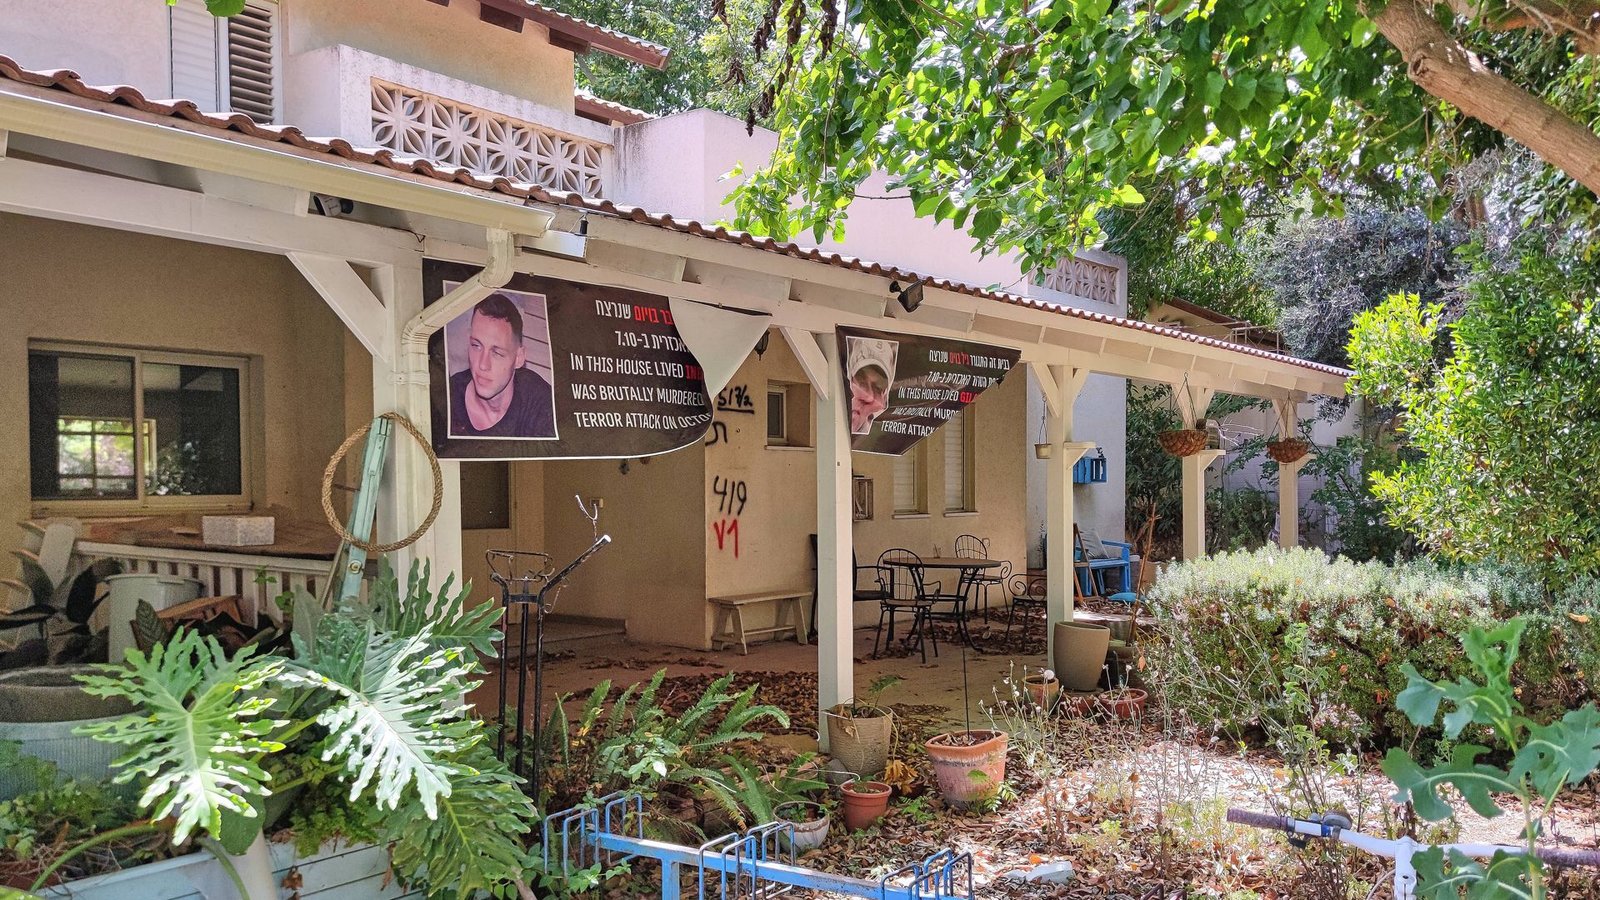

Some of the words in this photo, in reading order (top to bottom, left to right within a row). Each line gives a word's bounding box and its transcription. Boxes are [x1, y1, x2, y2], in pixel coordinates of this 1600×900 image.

[596, 300, 632, 320] שנרצח
[634, 306, 659, 322] בוים
[652, 334, 688, 352] אכזרית
[570, 352, 584, 371] IN
[586, 356, 614, 374] THIS
[616, 358, 653, 376] HOUSE
[654, 362, 684, 378] LIVED
[929, 350, 948, 362] שנרצח
[571, 384, 597, 400] WAS
[600, 385, 654, 402] BRUTALLY
[656, 388, 705, 406] MURDERED
[898, 386, 906, 399] IN
[906, 388, 921, 399] THIS
[921, 388, 941, 400] HOUSE
[574, 412, 624, 428] TERROR
[626, 413, 660, 430] ATTACK
[663, 416, 678, 430] ON
[880, 420, 906, 434] TERROR
[908, 424, 935, 436] ATTACK
